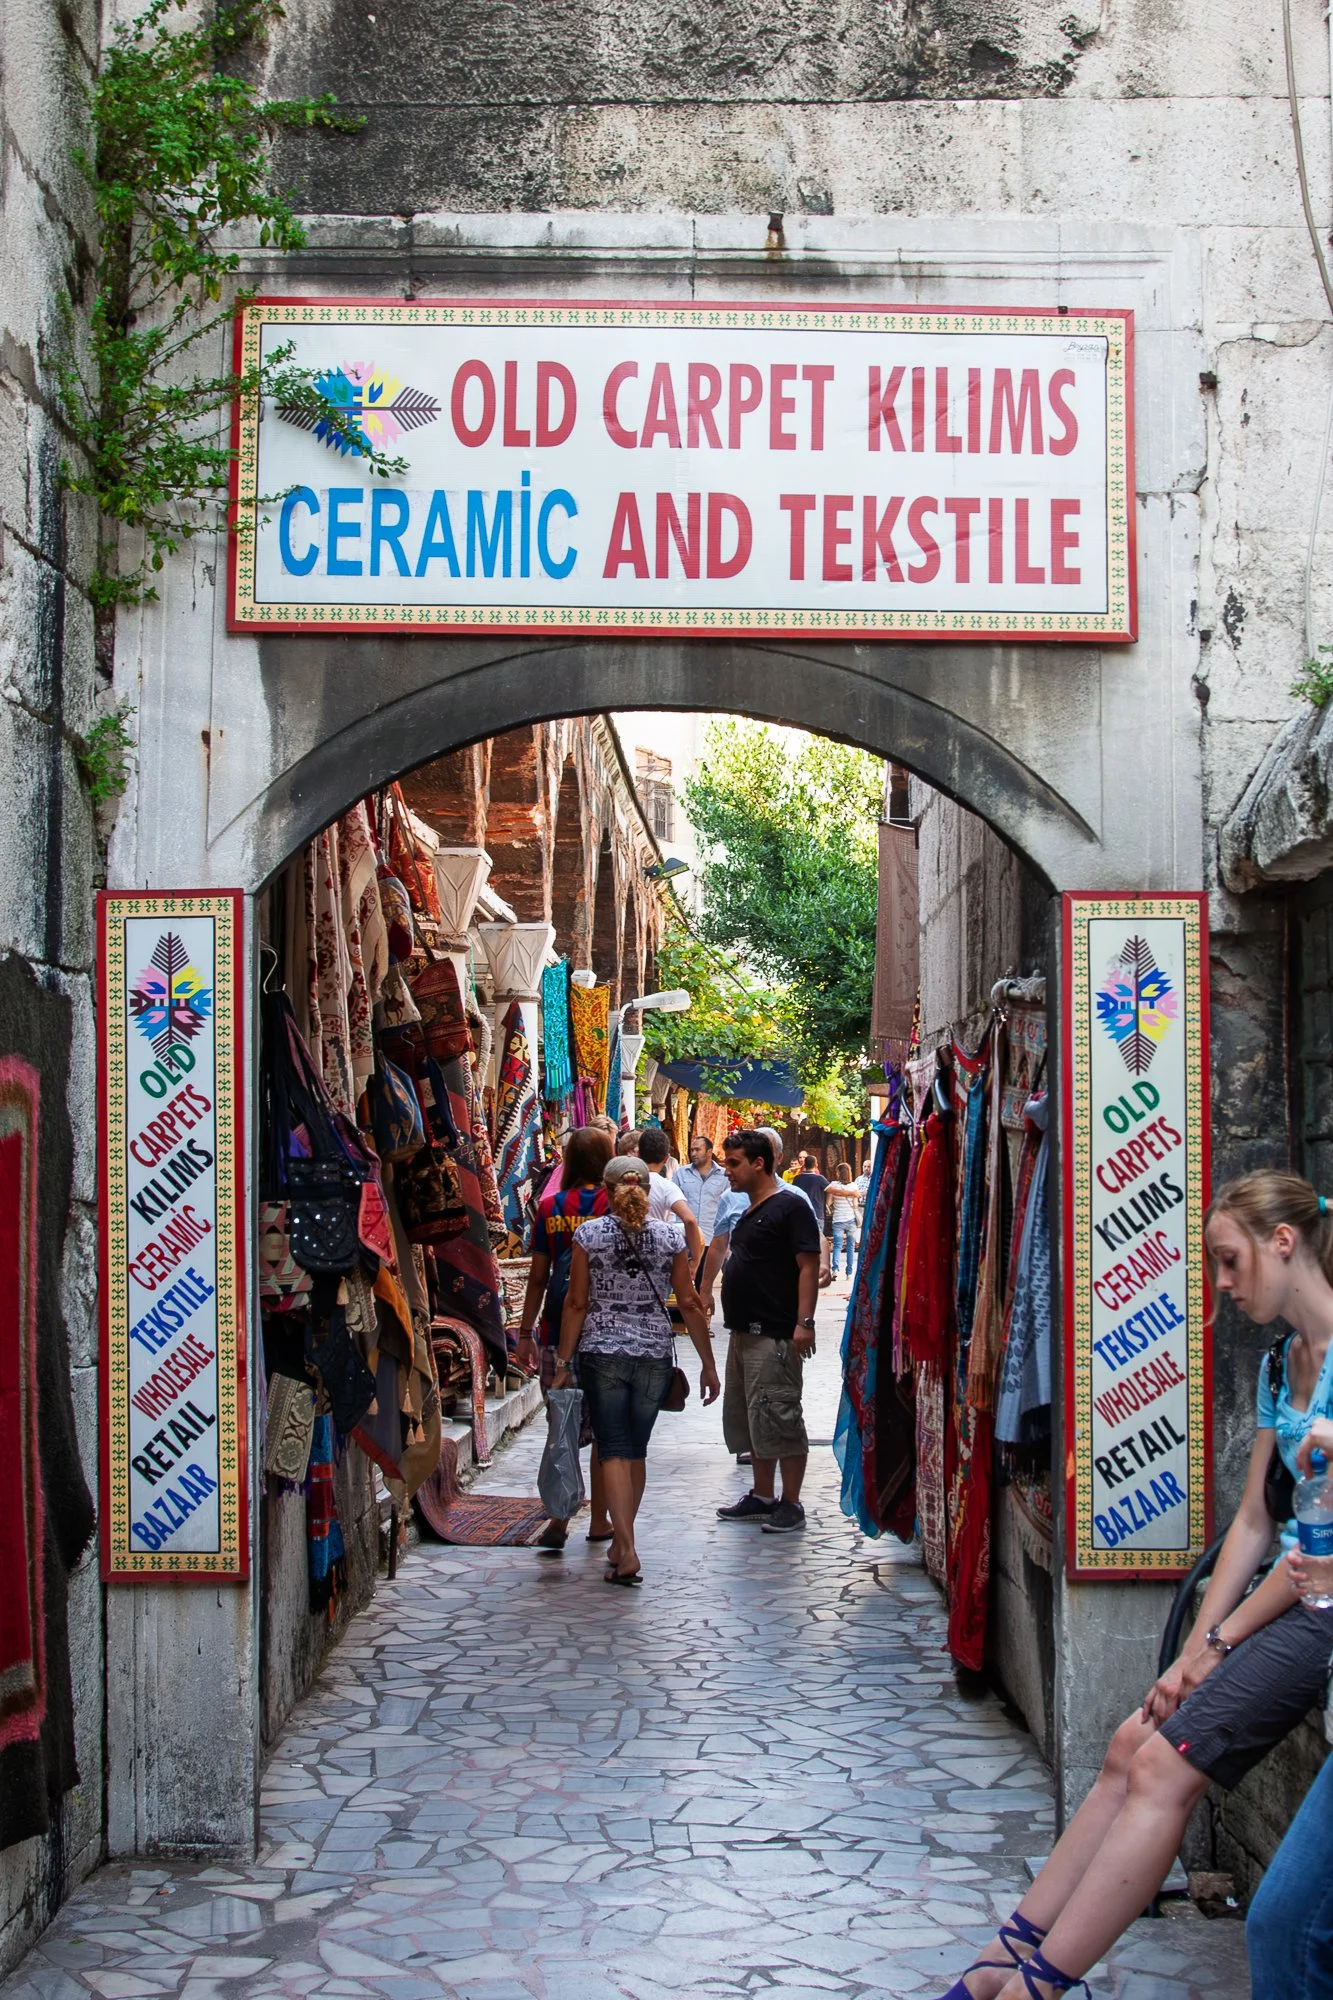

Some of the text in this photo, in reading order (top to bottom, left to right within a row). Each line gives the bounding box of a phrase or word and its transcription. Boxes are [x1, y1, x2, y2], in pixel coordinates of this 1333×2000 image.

[451, 359, 1078, 456] OLD CARPET KILIMS
[603, 492, 753, 579] AND
[779, 494, 1081, 585] TEKSTILE
[139, 1043, 196, 1099] OLD
[1102, 1080, 1161, 1134] OLD
[130, 1084, 212, 1168] CARPETS
[1096, 1116, 1182, 1194] CARPETS
[130, 1138, 214, 1225] KILIMS
[1094, 1172, 1184, 1252] KILIMS
[130, 1267, 215, 1355] TEKSTILE
[1093, 1292, 1186, 1372] TEKSTILE
[131, 1333, 215, 1421] WHOLESALE
[1094, 1350, 1187, 1428] WHOLESALE
[131, 1400, 216, 1486] RETAIL
[1094, 1415, 1186, 1489] RETAIL
[131, 1463, 218, 1550] BAZAAR
[1094, 1470, 1188, 1548] BAZAAR
